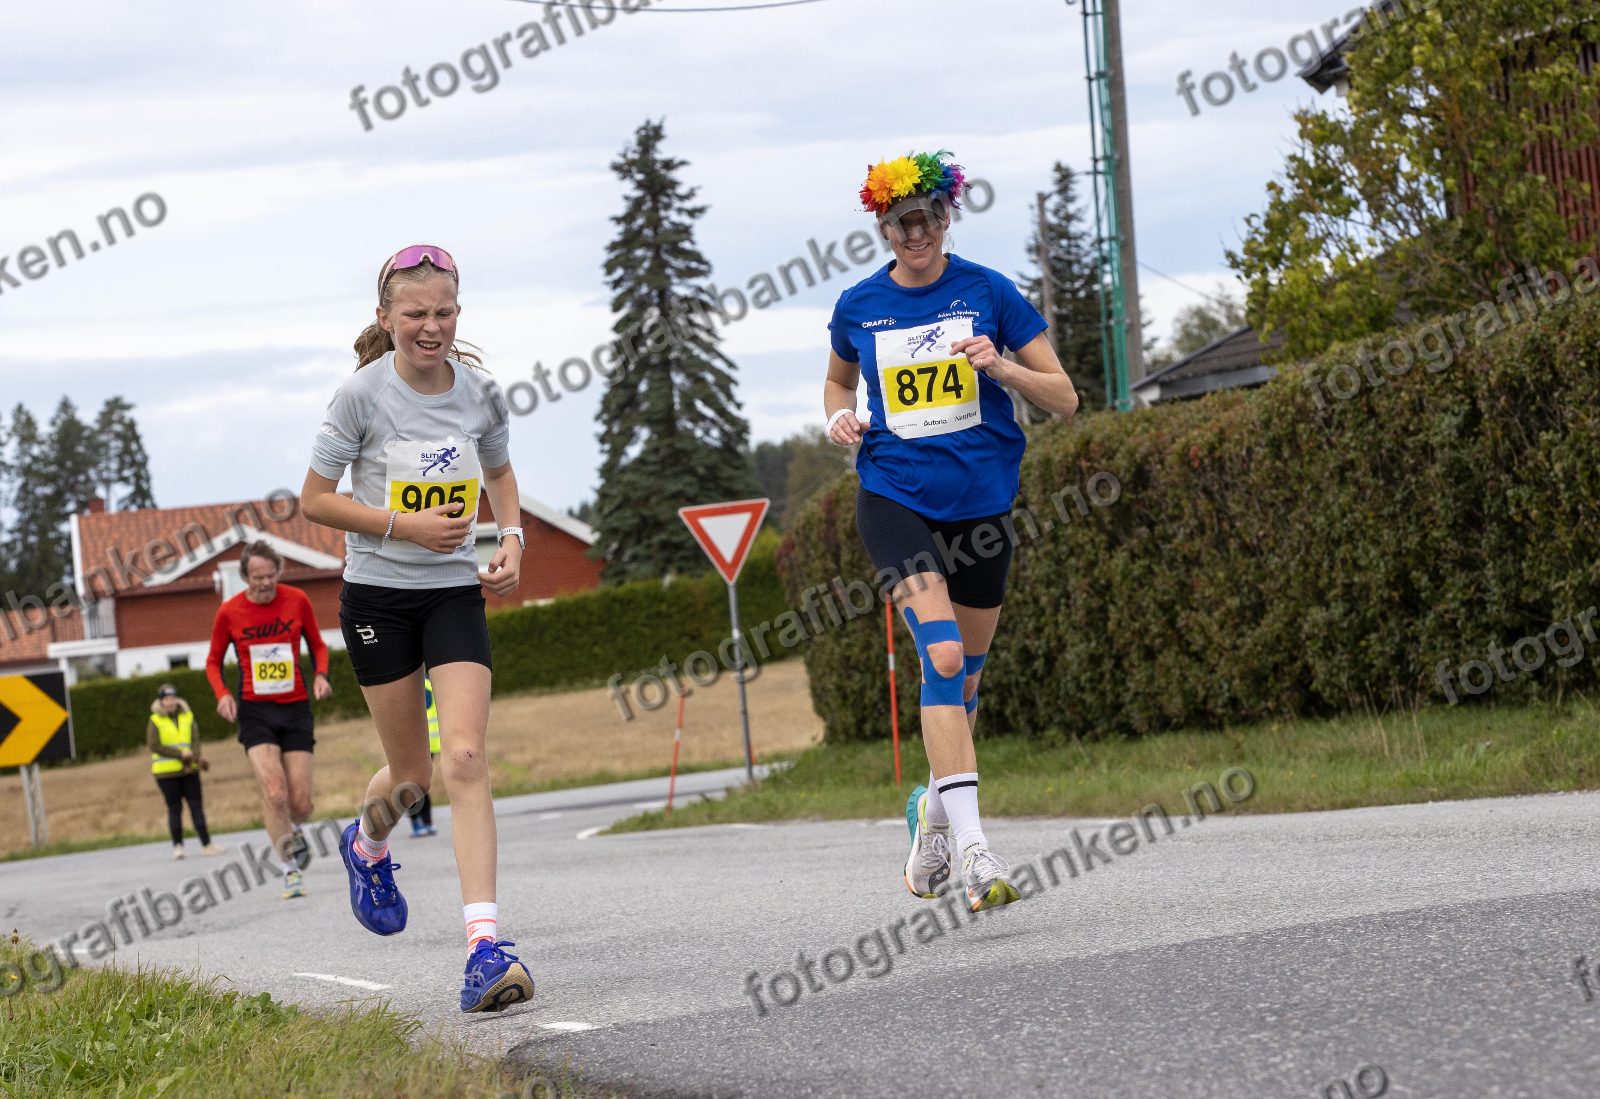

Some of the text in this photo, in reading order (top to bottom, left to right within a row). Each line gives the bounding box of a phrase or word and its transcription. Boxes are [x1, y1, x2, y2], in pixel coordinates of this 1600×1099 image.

[862, 319, 888, 329] CRAFT
[896, 363, 964, 406] 874
[401, 484, 466, 519] 905
[240, 617, 294, 641] SWIX
[258, 662, 287, 680] 829
